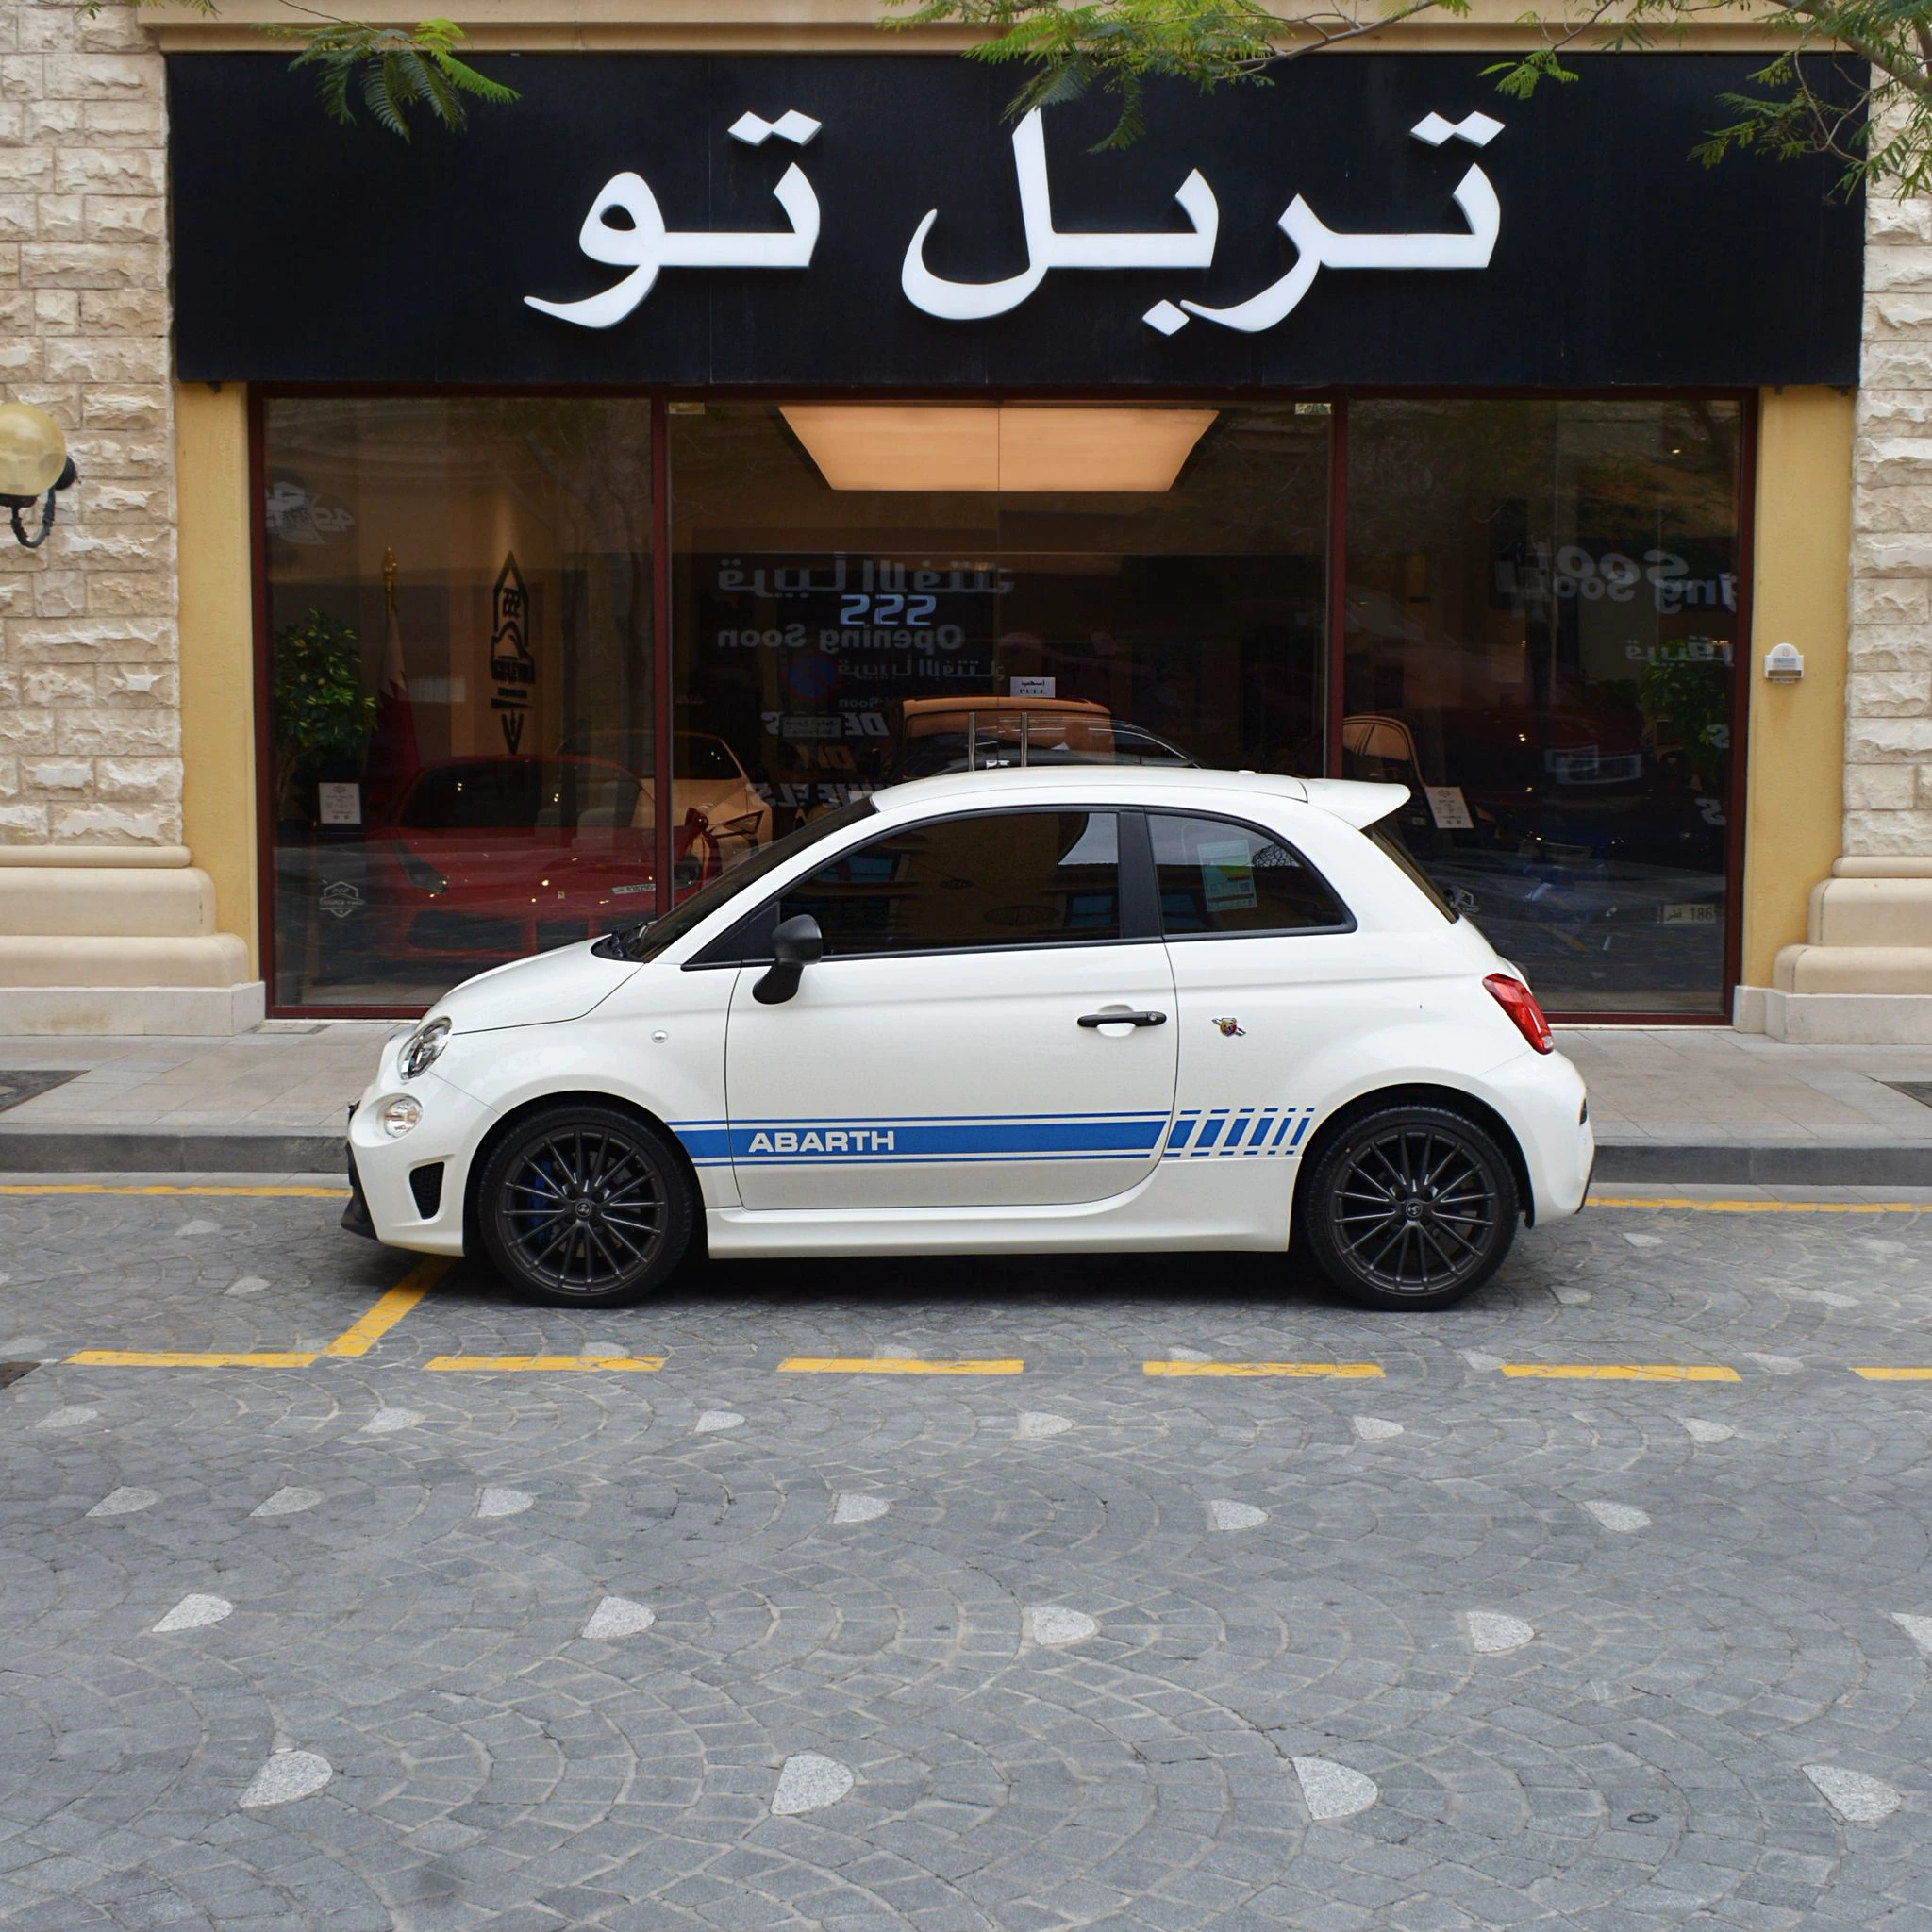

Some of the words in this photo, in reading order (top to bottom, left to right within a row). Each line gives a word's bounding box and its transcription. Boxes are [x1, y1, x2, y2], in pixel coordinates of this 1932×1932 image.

[523, 109, 823, 330] تو
[902, 108, 1506, 336] تربل
[840, 594, 936, 625] 222
[1690, 906, 1714, 922] 186
[747, 1130, 895, 1153] ABARTH
